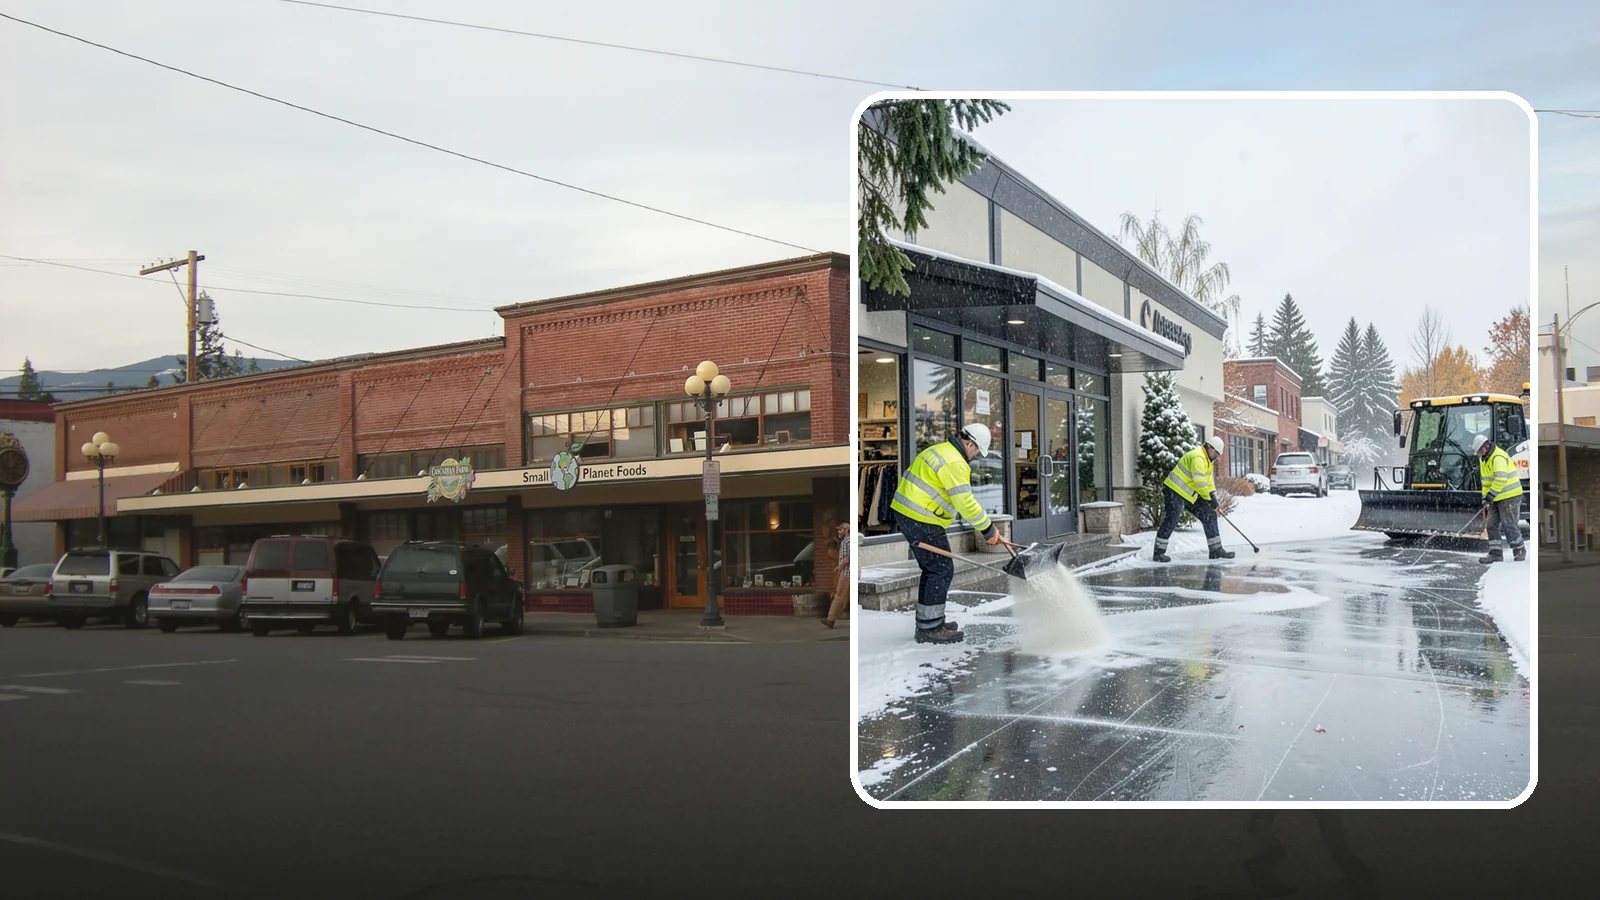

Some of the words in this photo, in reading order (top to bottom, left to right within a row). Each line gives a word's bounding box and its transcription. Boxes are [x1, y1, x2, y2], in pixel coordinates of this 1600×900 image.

[523, 471, 549, 483] Small
[583, 467, 614, 480] Planet
[617, 464, 647, 477] Foods
